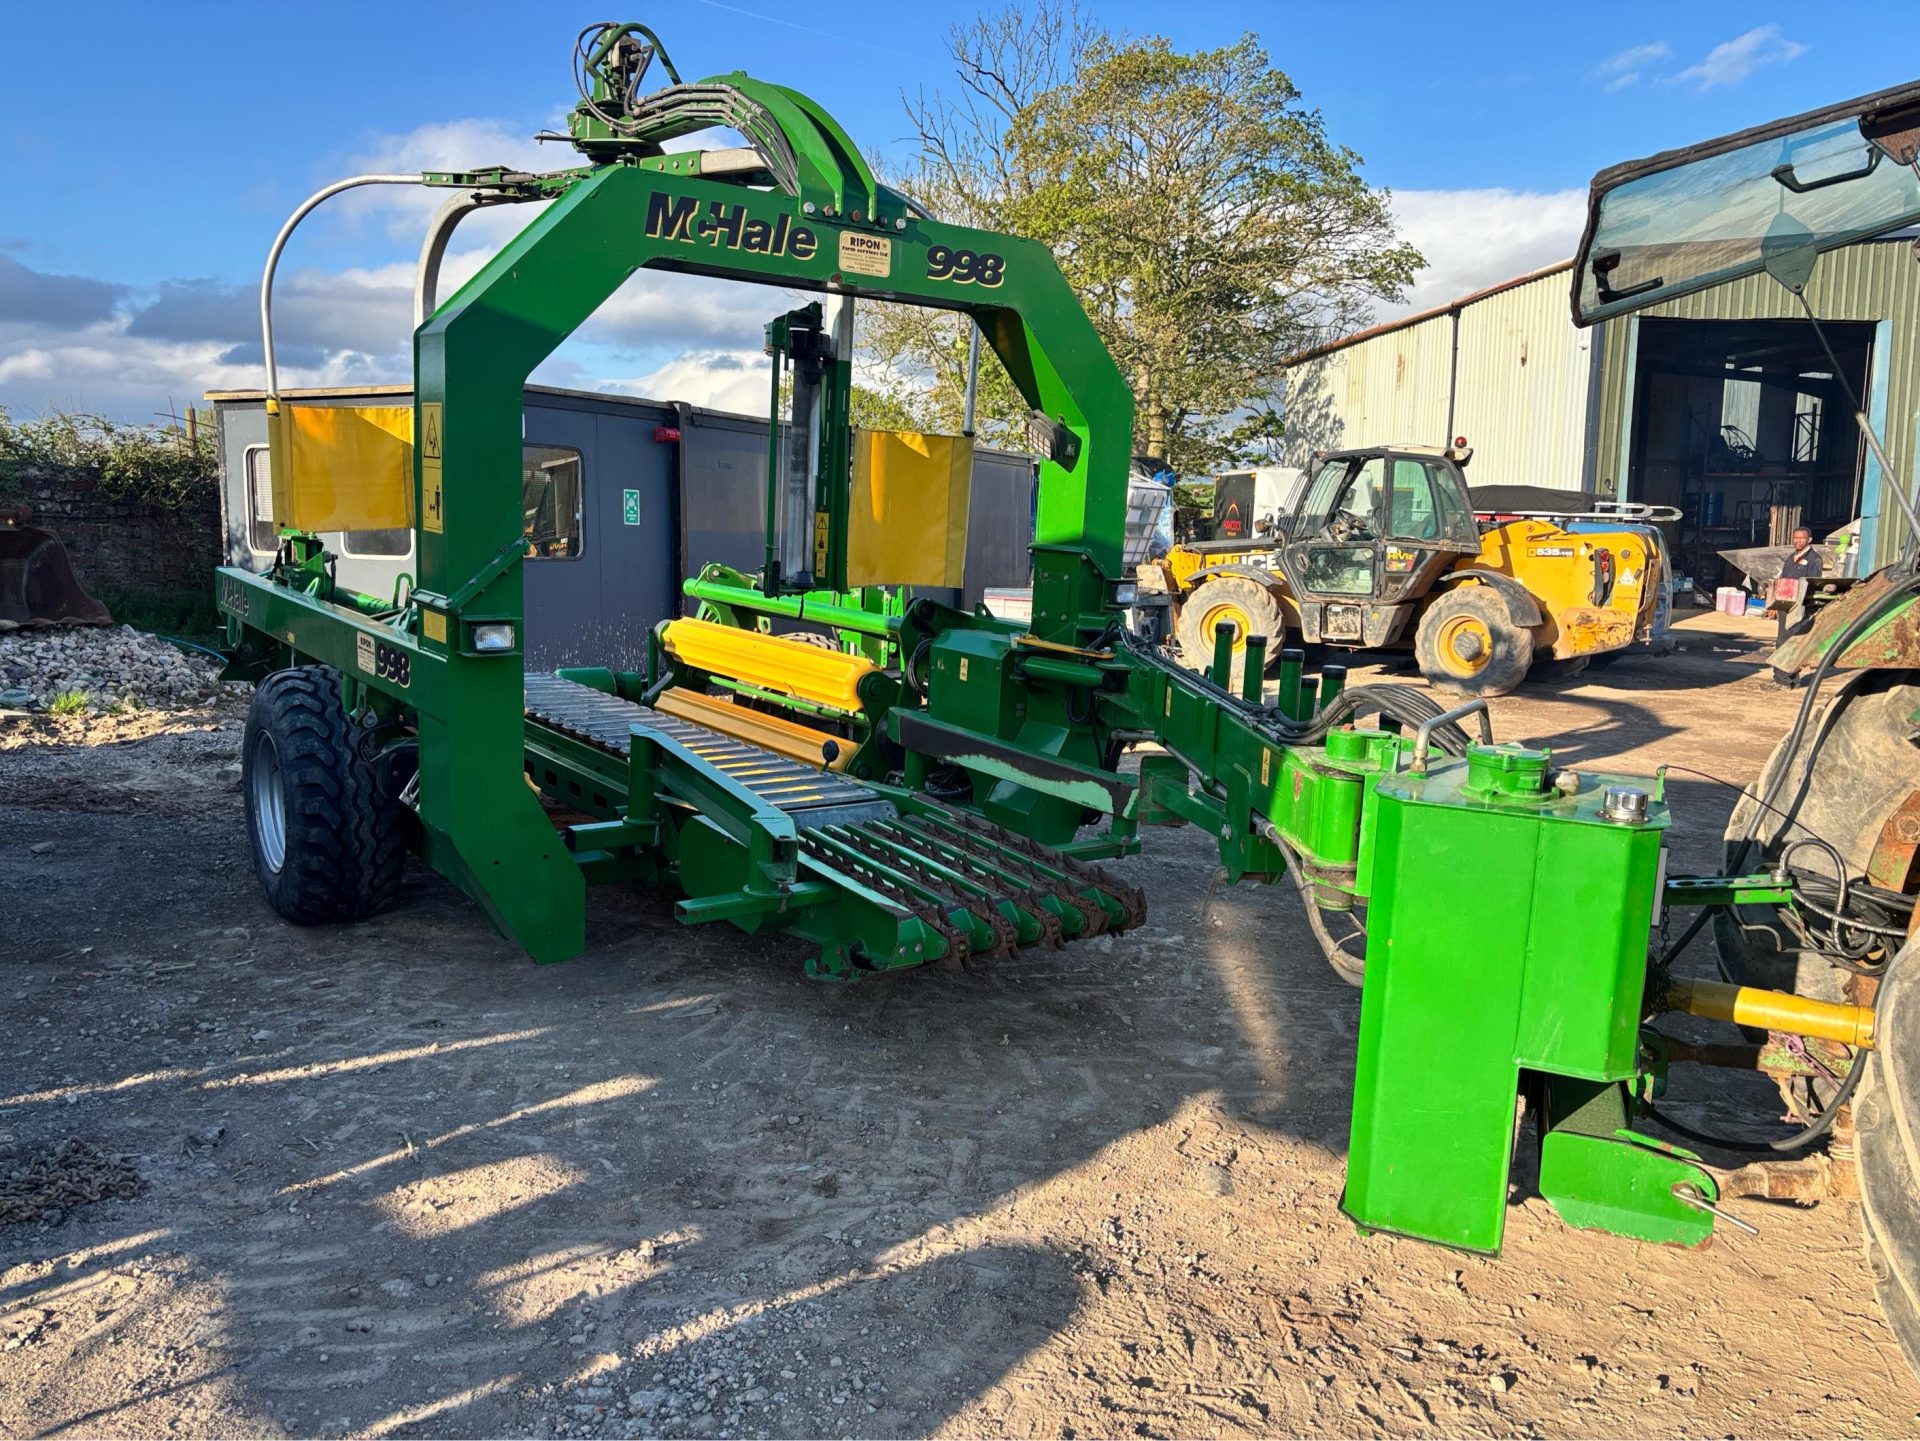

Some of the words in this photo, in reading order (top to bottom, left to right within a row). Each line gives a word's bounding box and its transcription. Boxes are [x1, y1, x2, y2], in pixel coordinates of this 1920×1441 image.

[645, 191, 818, 261] McHale
[850, 236, 880, 250] RIPON
[927, 245, 1006, 288] 998
[377, 642, 411, 689] 998
